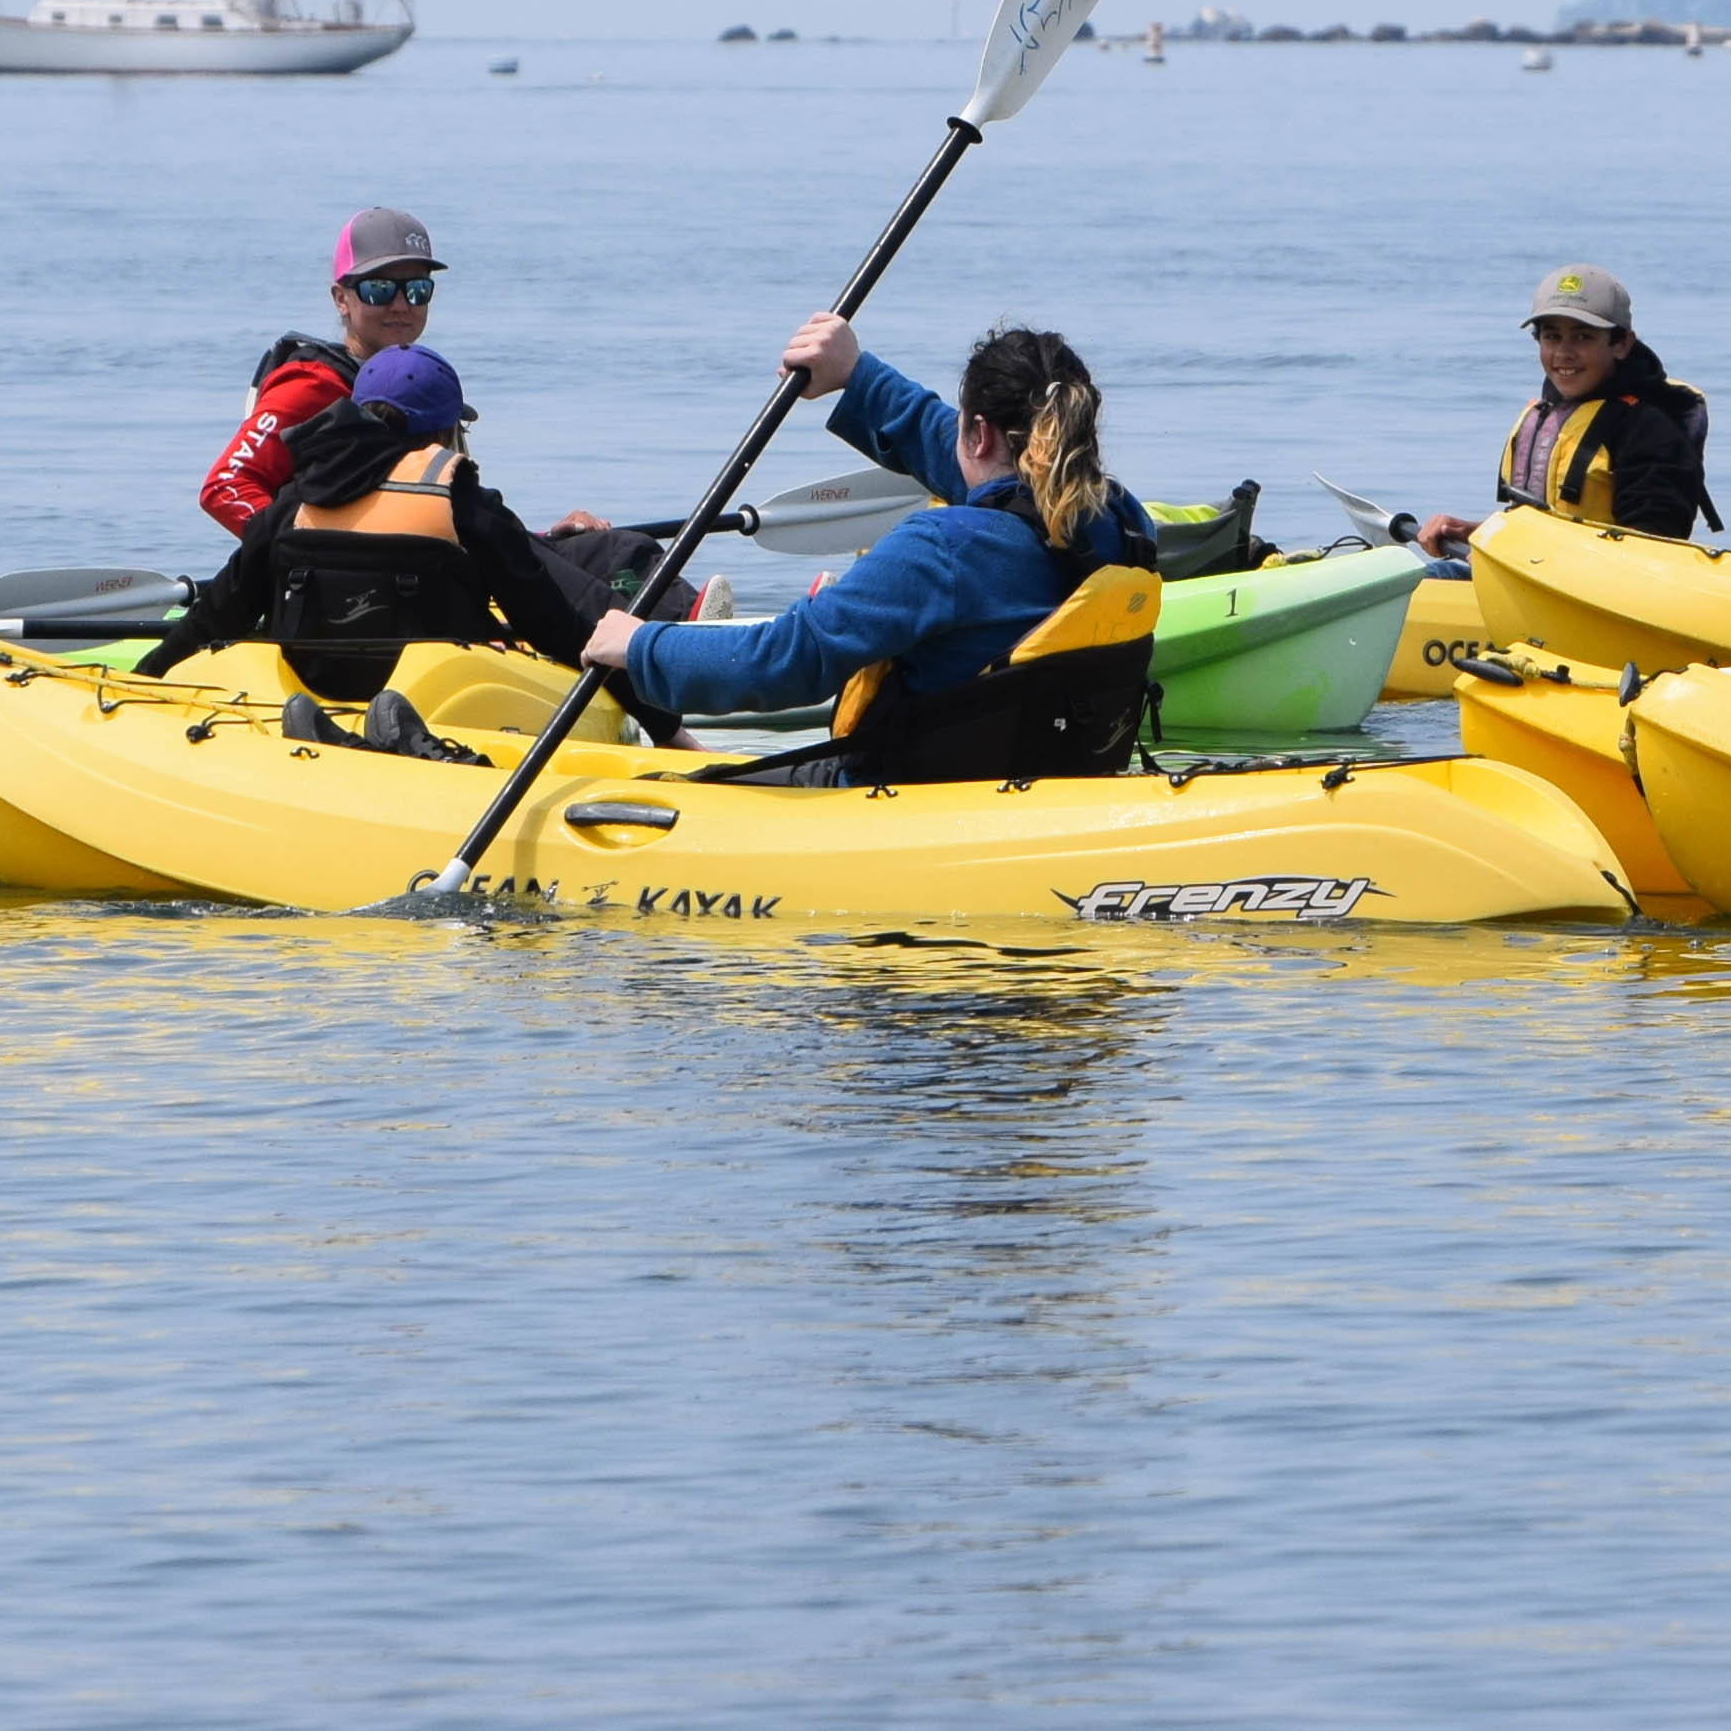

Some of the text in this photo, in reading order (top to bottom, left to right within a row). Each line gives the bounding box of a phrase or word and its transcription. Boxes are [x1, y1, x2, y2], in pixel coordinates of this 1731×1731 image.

[1225, 588, 1239, 618] 1
[1422, 639, 1496, 668] OCE
[406, 868, 782, 919] OEAN KAYAK
[1076, 877, 1370, 920] Frenzy
